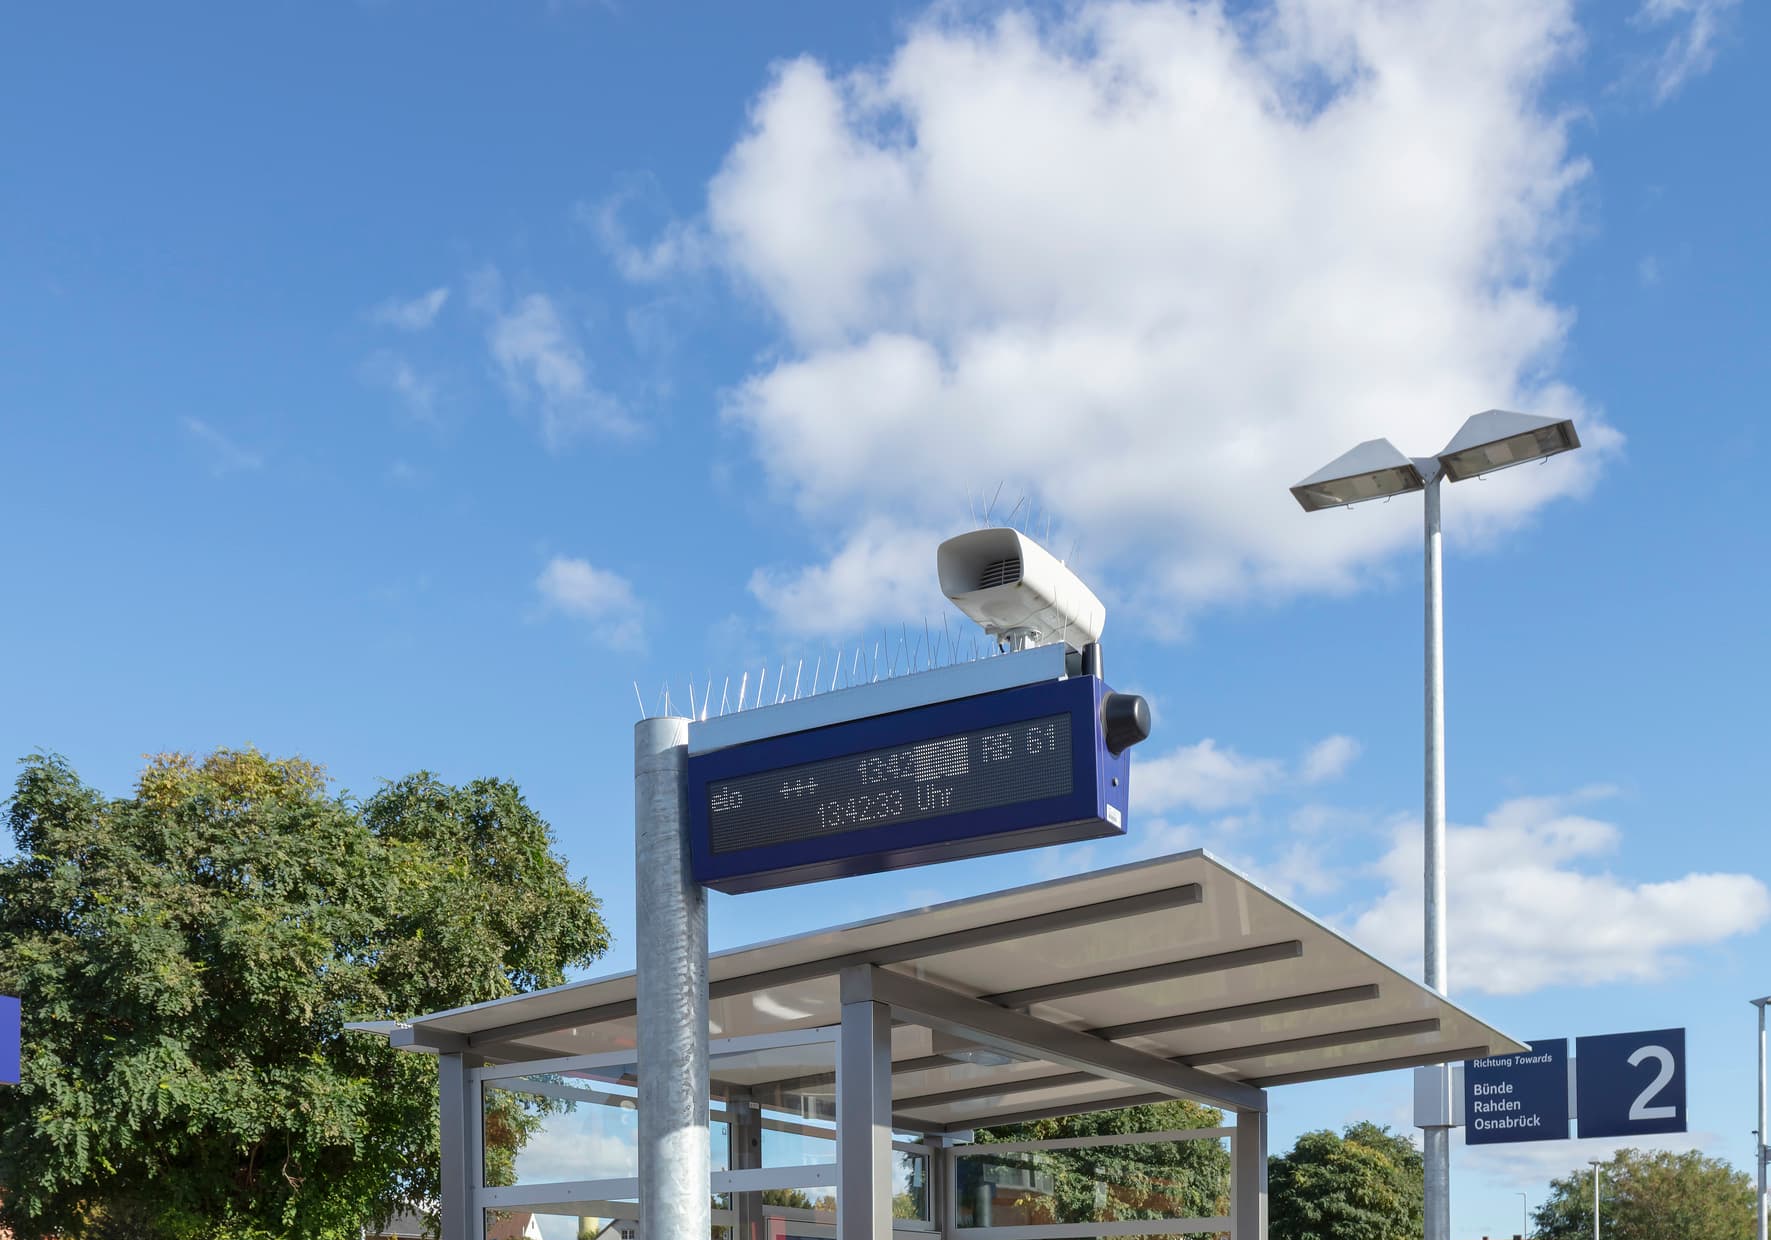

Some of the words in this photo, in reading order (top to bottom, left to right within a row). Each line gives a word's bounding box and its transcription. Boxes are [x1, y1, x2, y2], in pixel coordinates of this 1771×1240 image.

[981, 732, 1013, 763] RB
[1026, 723, 1056, 755] 61
[817, 789, 904, 828] 13:42:33
[916, 783, 954, 811] Uhr
[1473, 1057, 1512, 1069] Richtung
[1514, 1053, 1553, 1065] Towards
[1473, 1081, 1514, 1096] Bünde
[1626, 1044, 1677, 1121] 2
[1474, 1099, 1521, 1113] Rahden
[1474, 1113, 1542, 1130] Osnabrück
